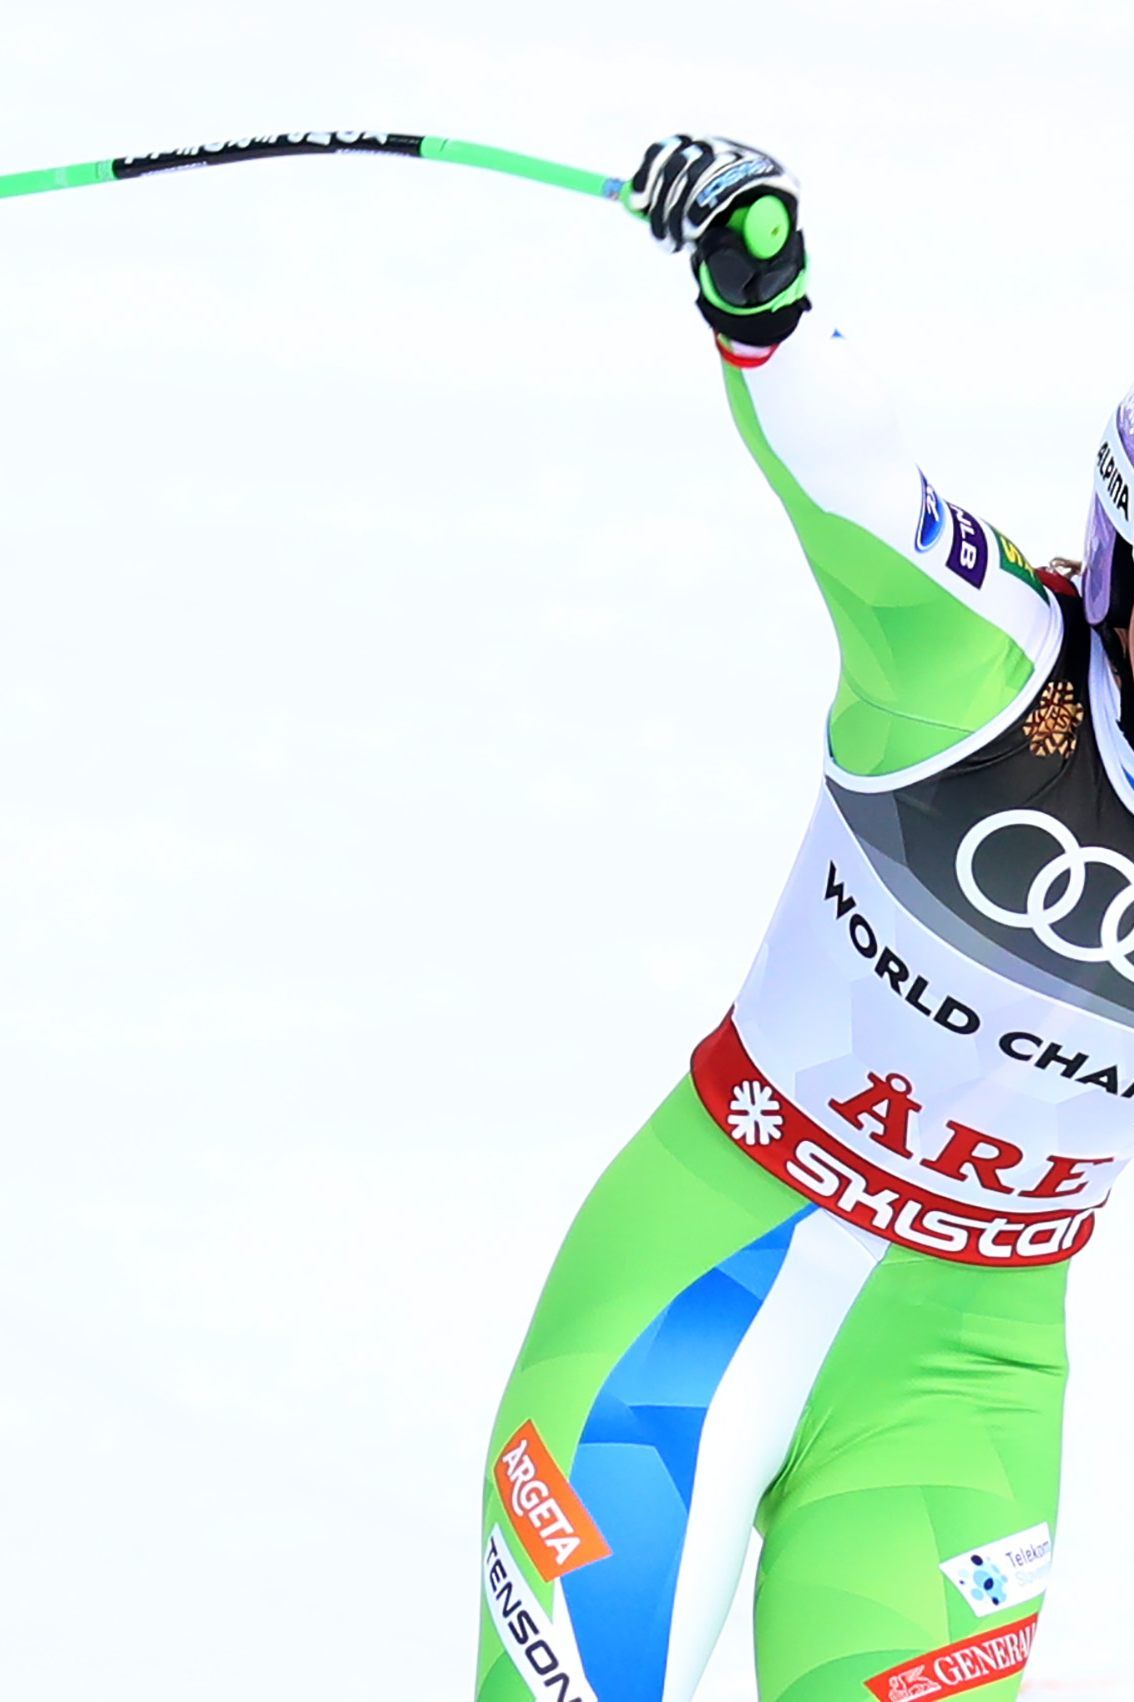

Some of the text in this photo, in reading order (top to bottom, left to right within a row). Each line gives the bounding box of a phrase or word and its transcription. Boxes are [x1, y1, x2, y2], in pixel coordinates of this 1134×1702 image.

[1096, 441, 1130, 521] ALPINA
[824, 859, 981, 1035] WORLD
[828, 1071, 1115, 1199] ÅRE
[501, 1439, 581, 1565] ARGETA
[486, 1535, 583, 1702] TENSON
